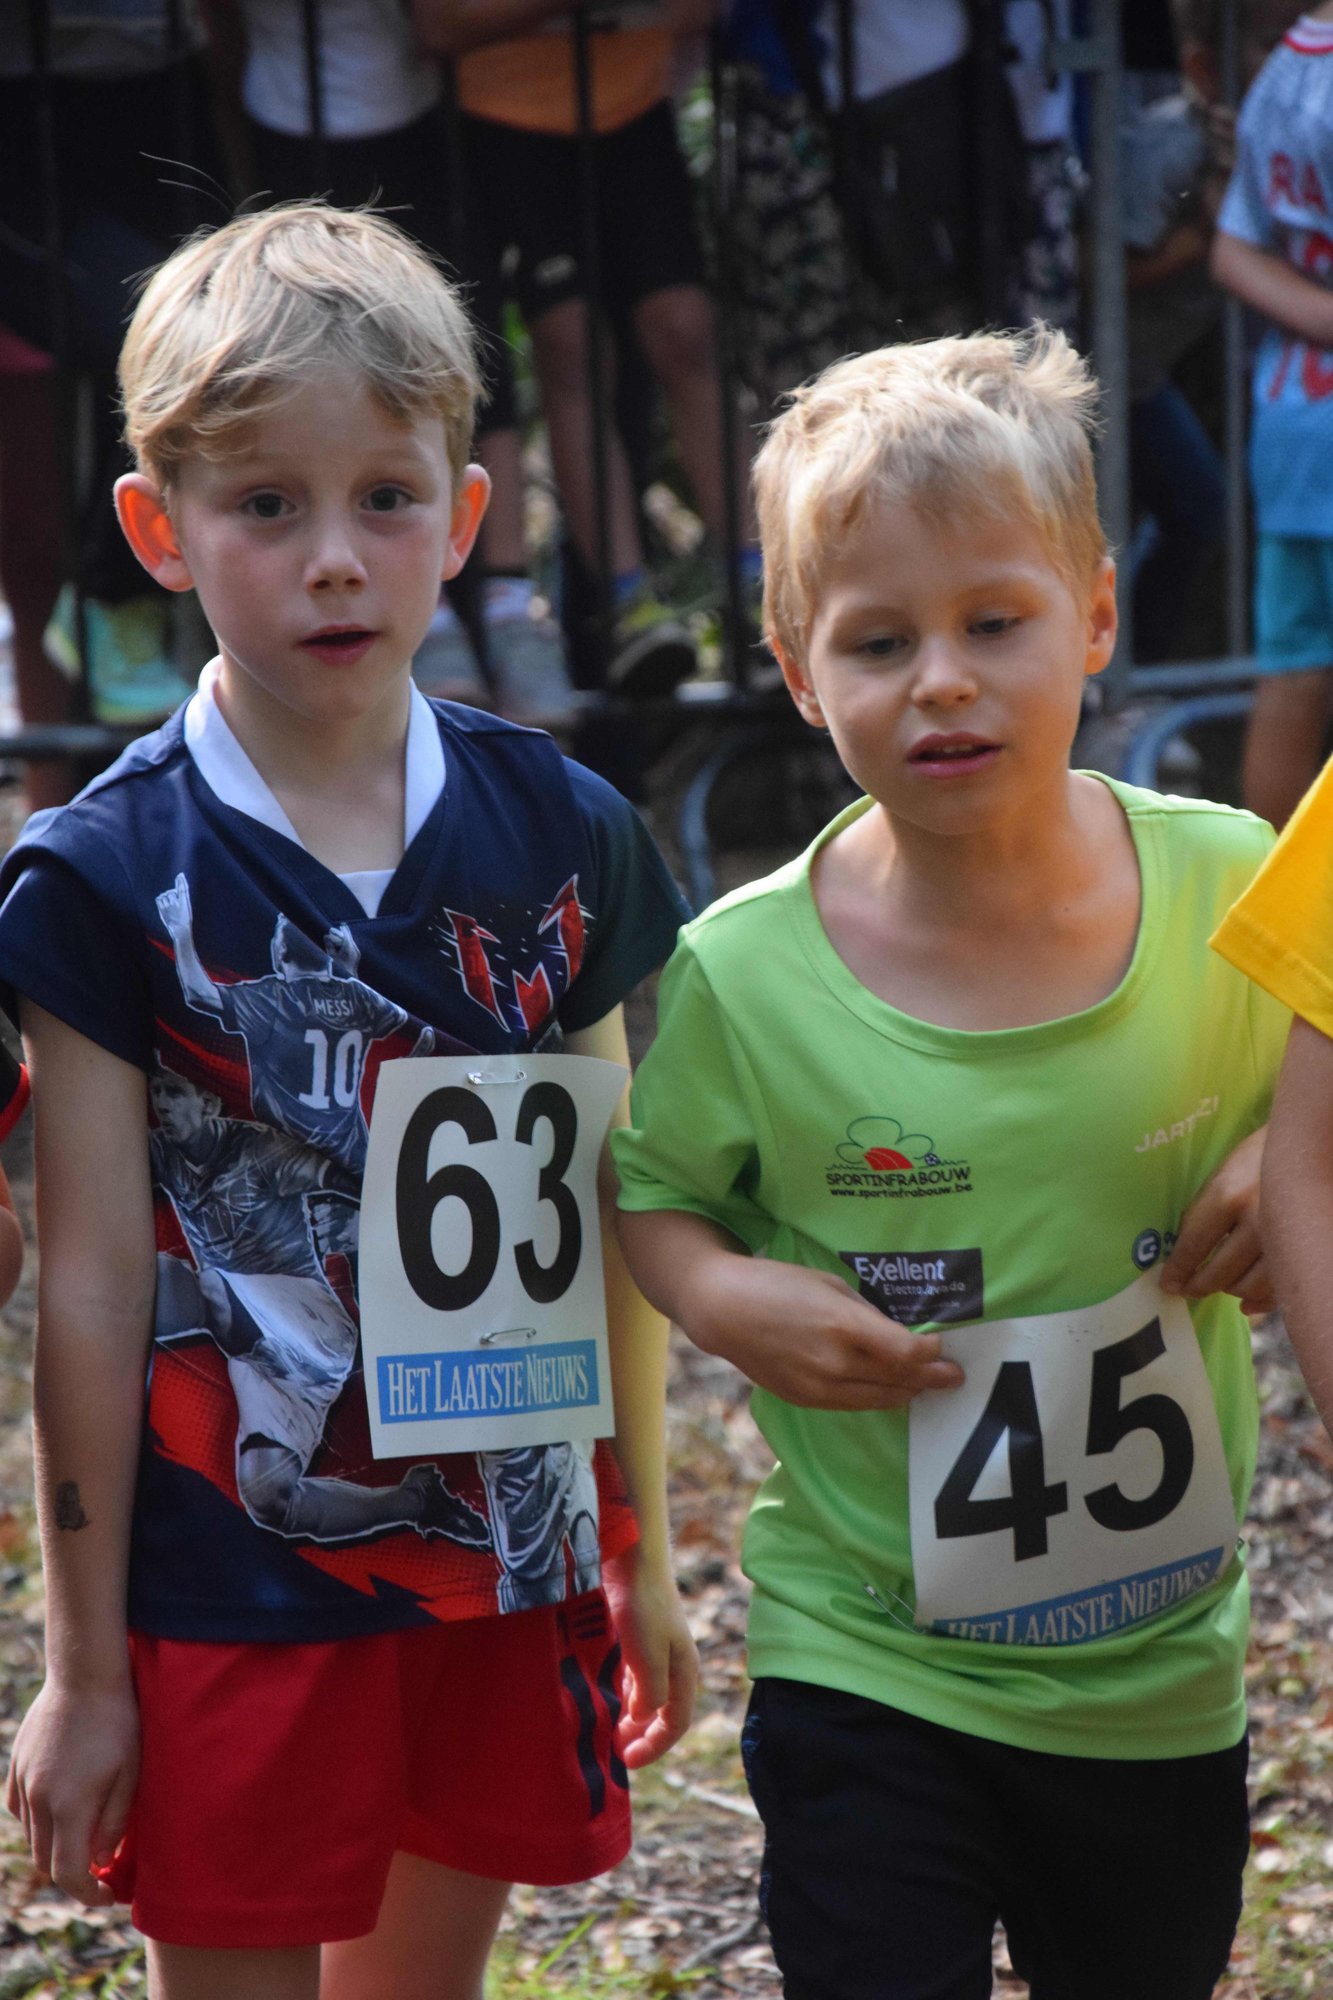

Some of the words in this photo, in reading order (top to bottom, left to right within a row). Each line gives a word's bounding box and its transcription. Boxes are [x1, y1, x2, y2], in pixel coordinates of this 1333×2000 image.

[313, 999, 354, 1016] MESSI
[298, 1028, 363, 1110] 10
[395, 1080, 582, 1312] 63
[825, 1166, 971, 1188] SPORTINFRABOUW
[829, 1182, 974, 1200] www.sportinfrabouw.be
[854, 1256, 946, 1287] Exellent
[387, 1361, 431, 1417] HET
[433, 1359, 524, 1413] LAATSTE
[525, 1353, 590, 1407] NIEUWS
[934, 1315, 1195, 1563] 45
[1006, 1593, 1115, 1644] LAATSTE
[1119, 1560, 1211, 1625] NIEUWS
